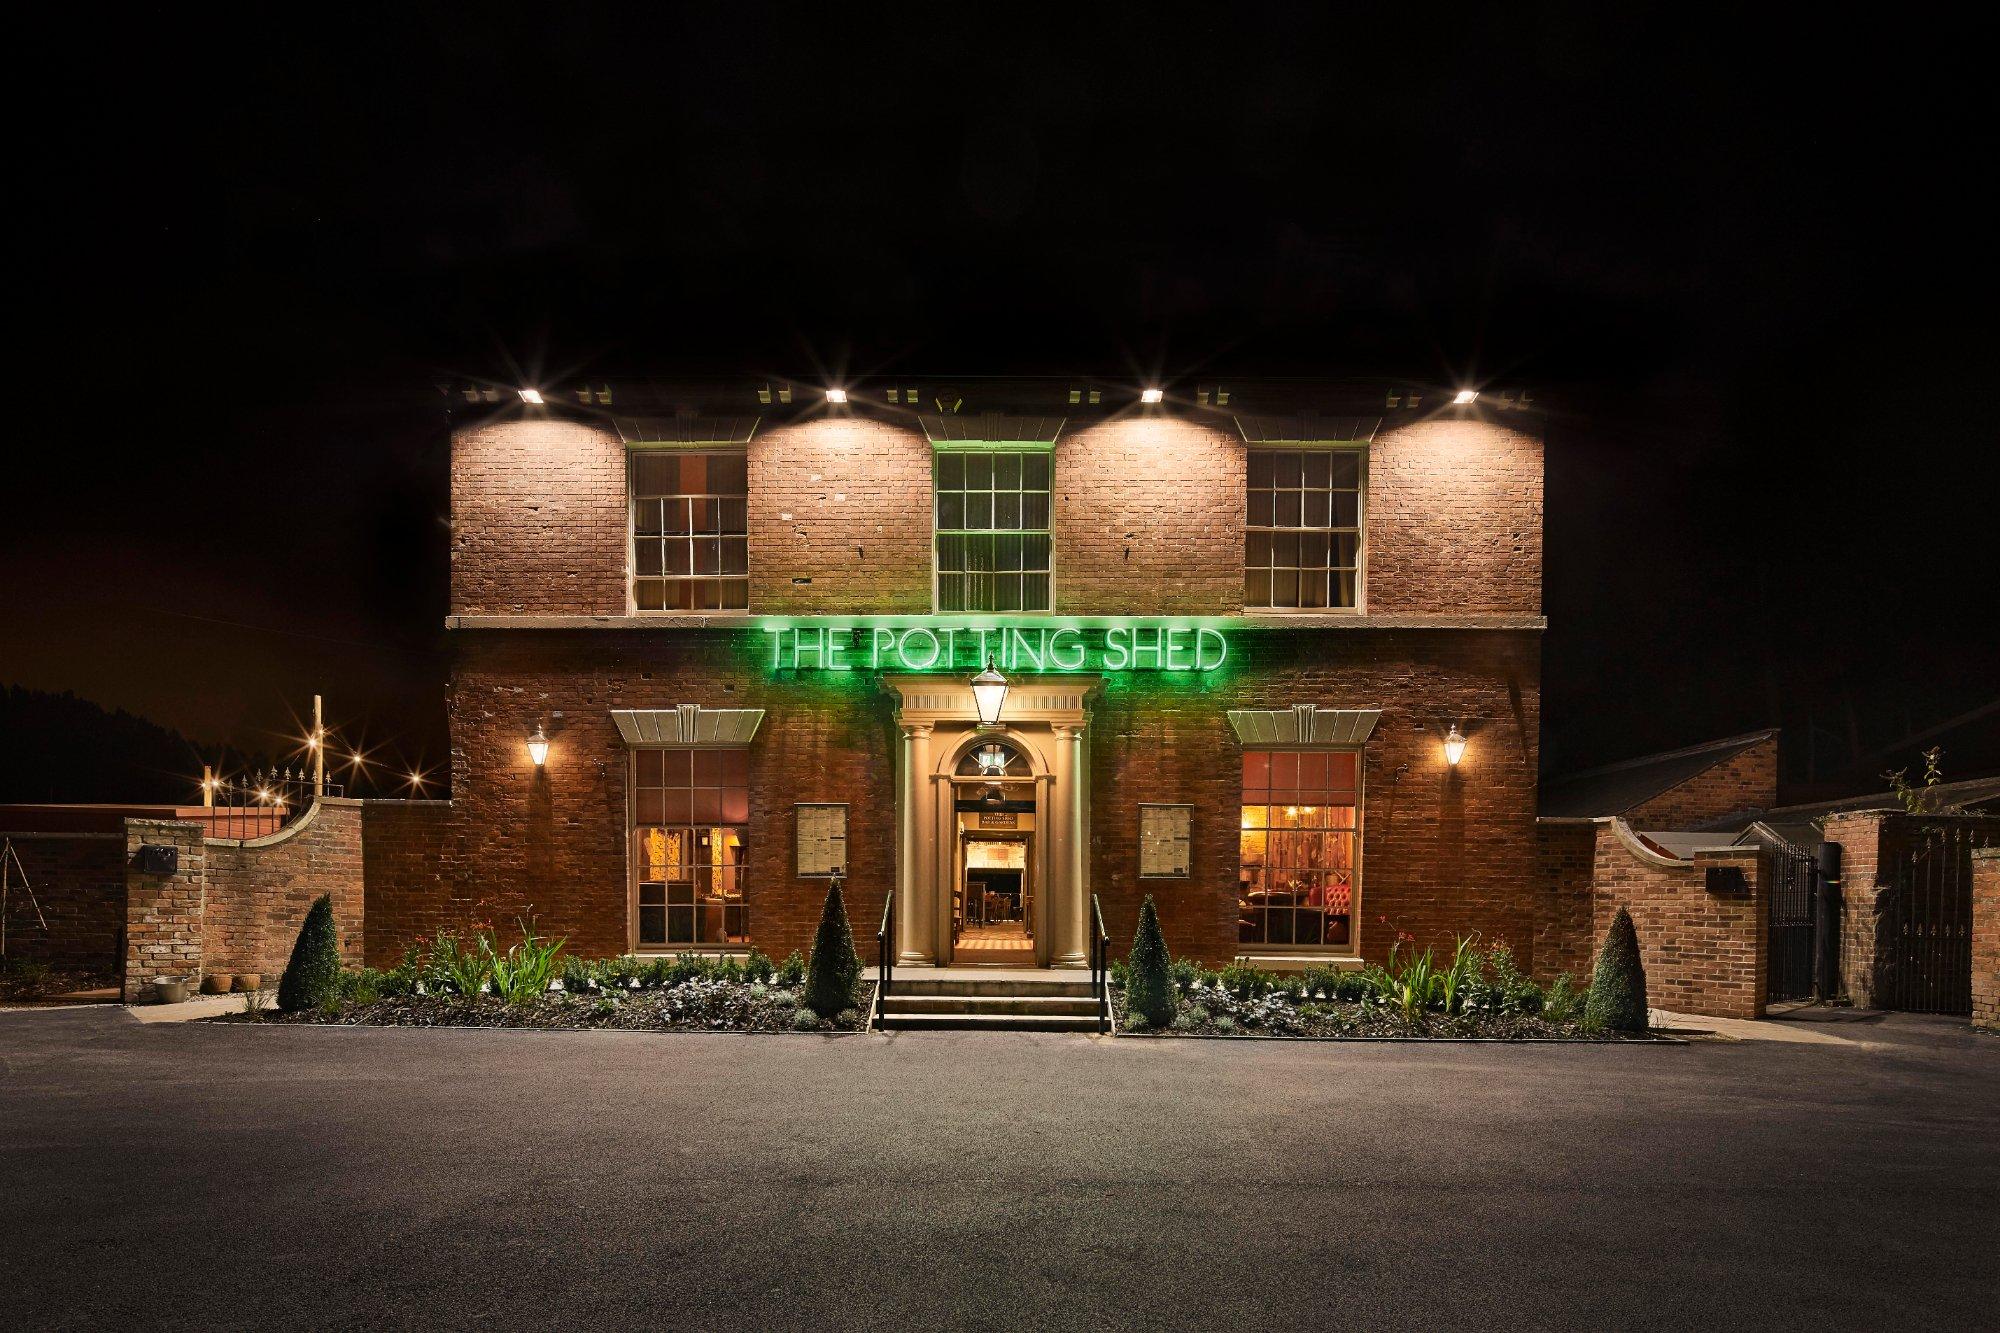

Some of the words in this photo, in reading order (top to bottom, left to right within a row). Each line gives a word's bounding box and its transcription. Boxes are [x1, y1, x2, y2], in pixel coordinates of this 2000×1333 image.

[763, 628, 851, 670] THE
[873, 628, 1085, 670] POTTING
[1103, 628, 1227, 671] SHED
